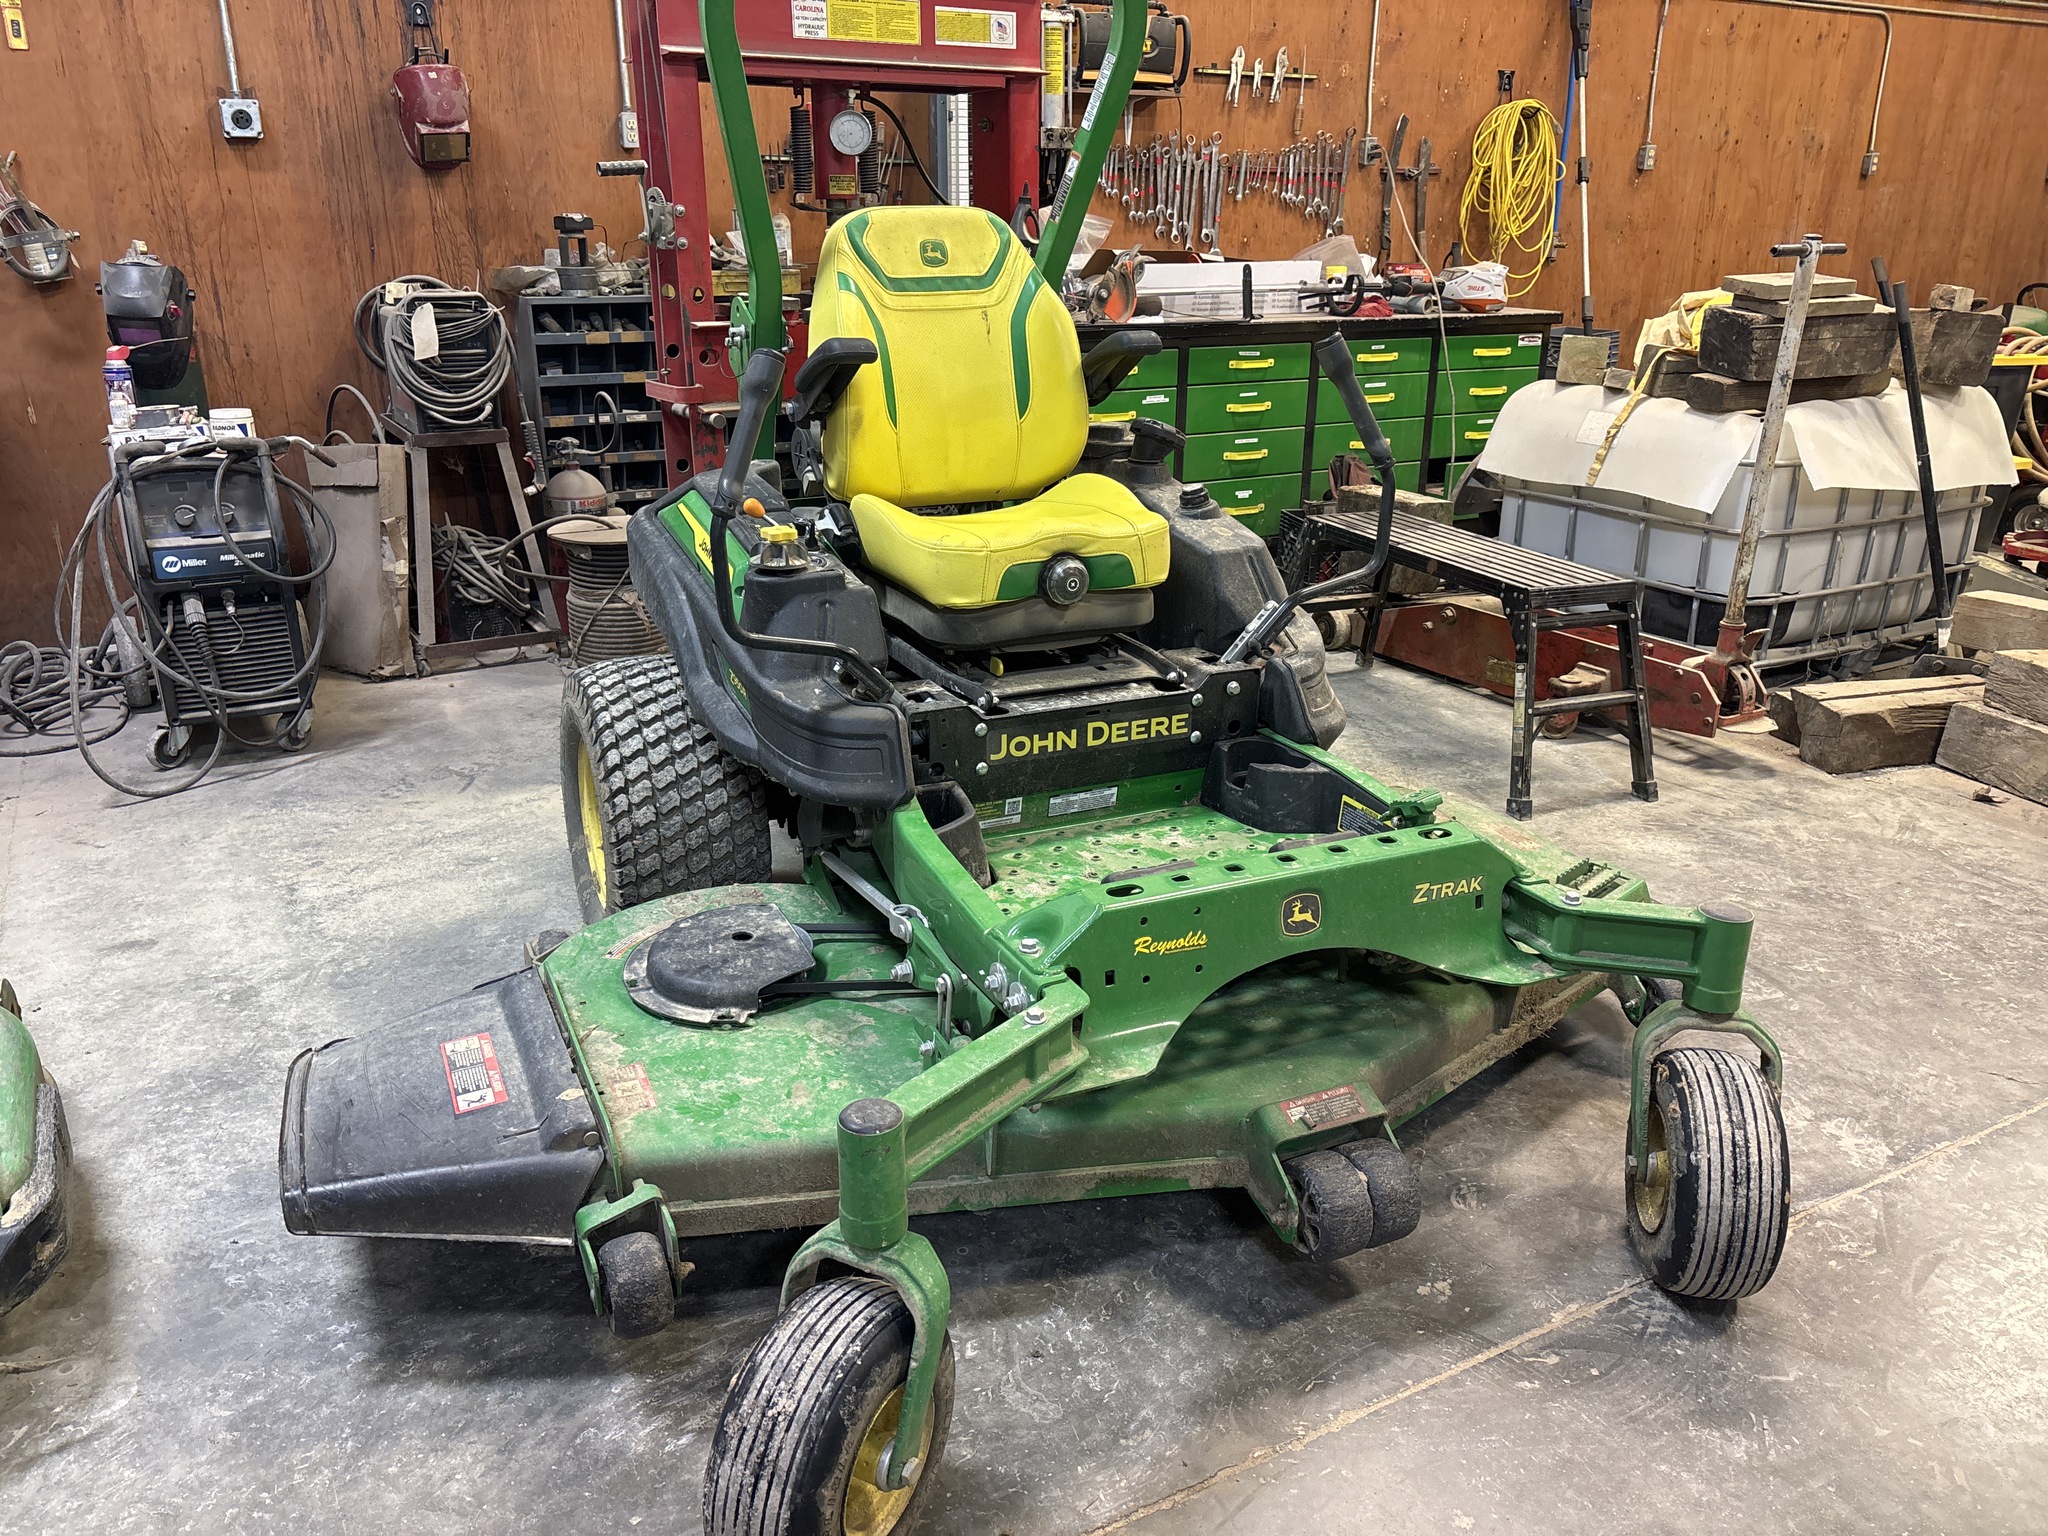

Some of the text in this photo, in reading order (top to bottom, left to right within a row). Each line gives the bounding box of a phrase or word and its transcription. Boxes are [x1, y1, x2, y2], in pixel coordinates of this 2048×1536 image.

[795, 4, 824, 13] CAROLINA
[182, 558, 207, 568] Miller
[989, 713, 1189, 761] JOHN DEERE
[1413, 875, 1484, 904] ZTRAK
[1133, 930, 1208, 956] Reynolds
